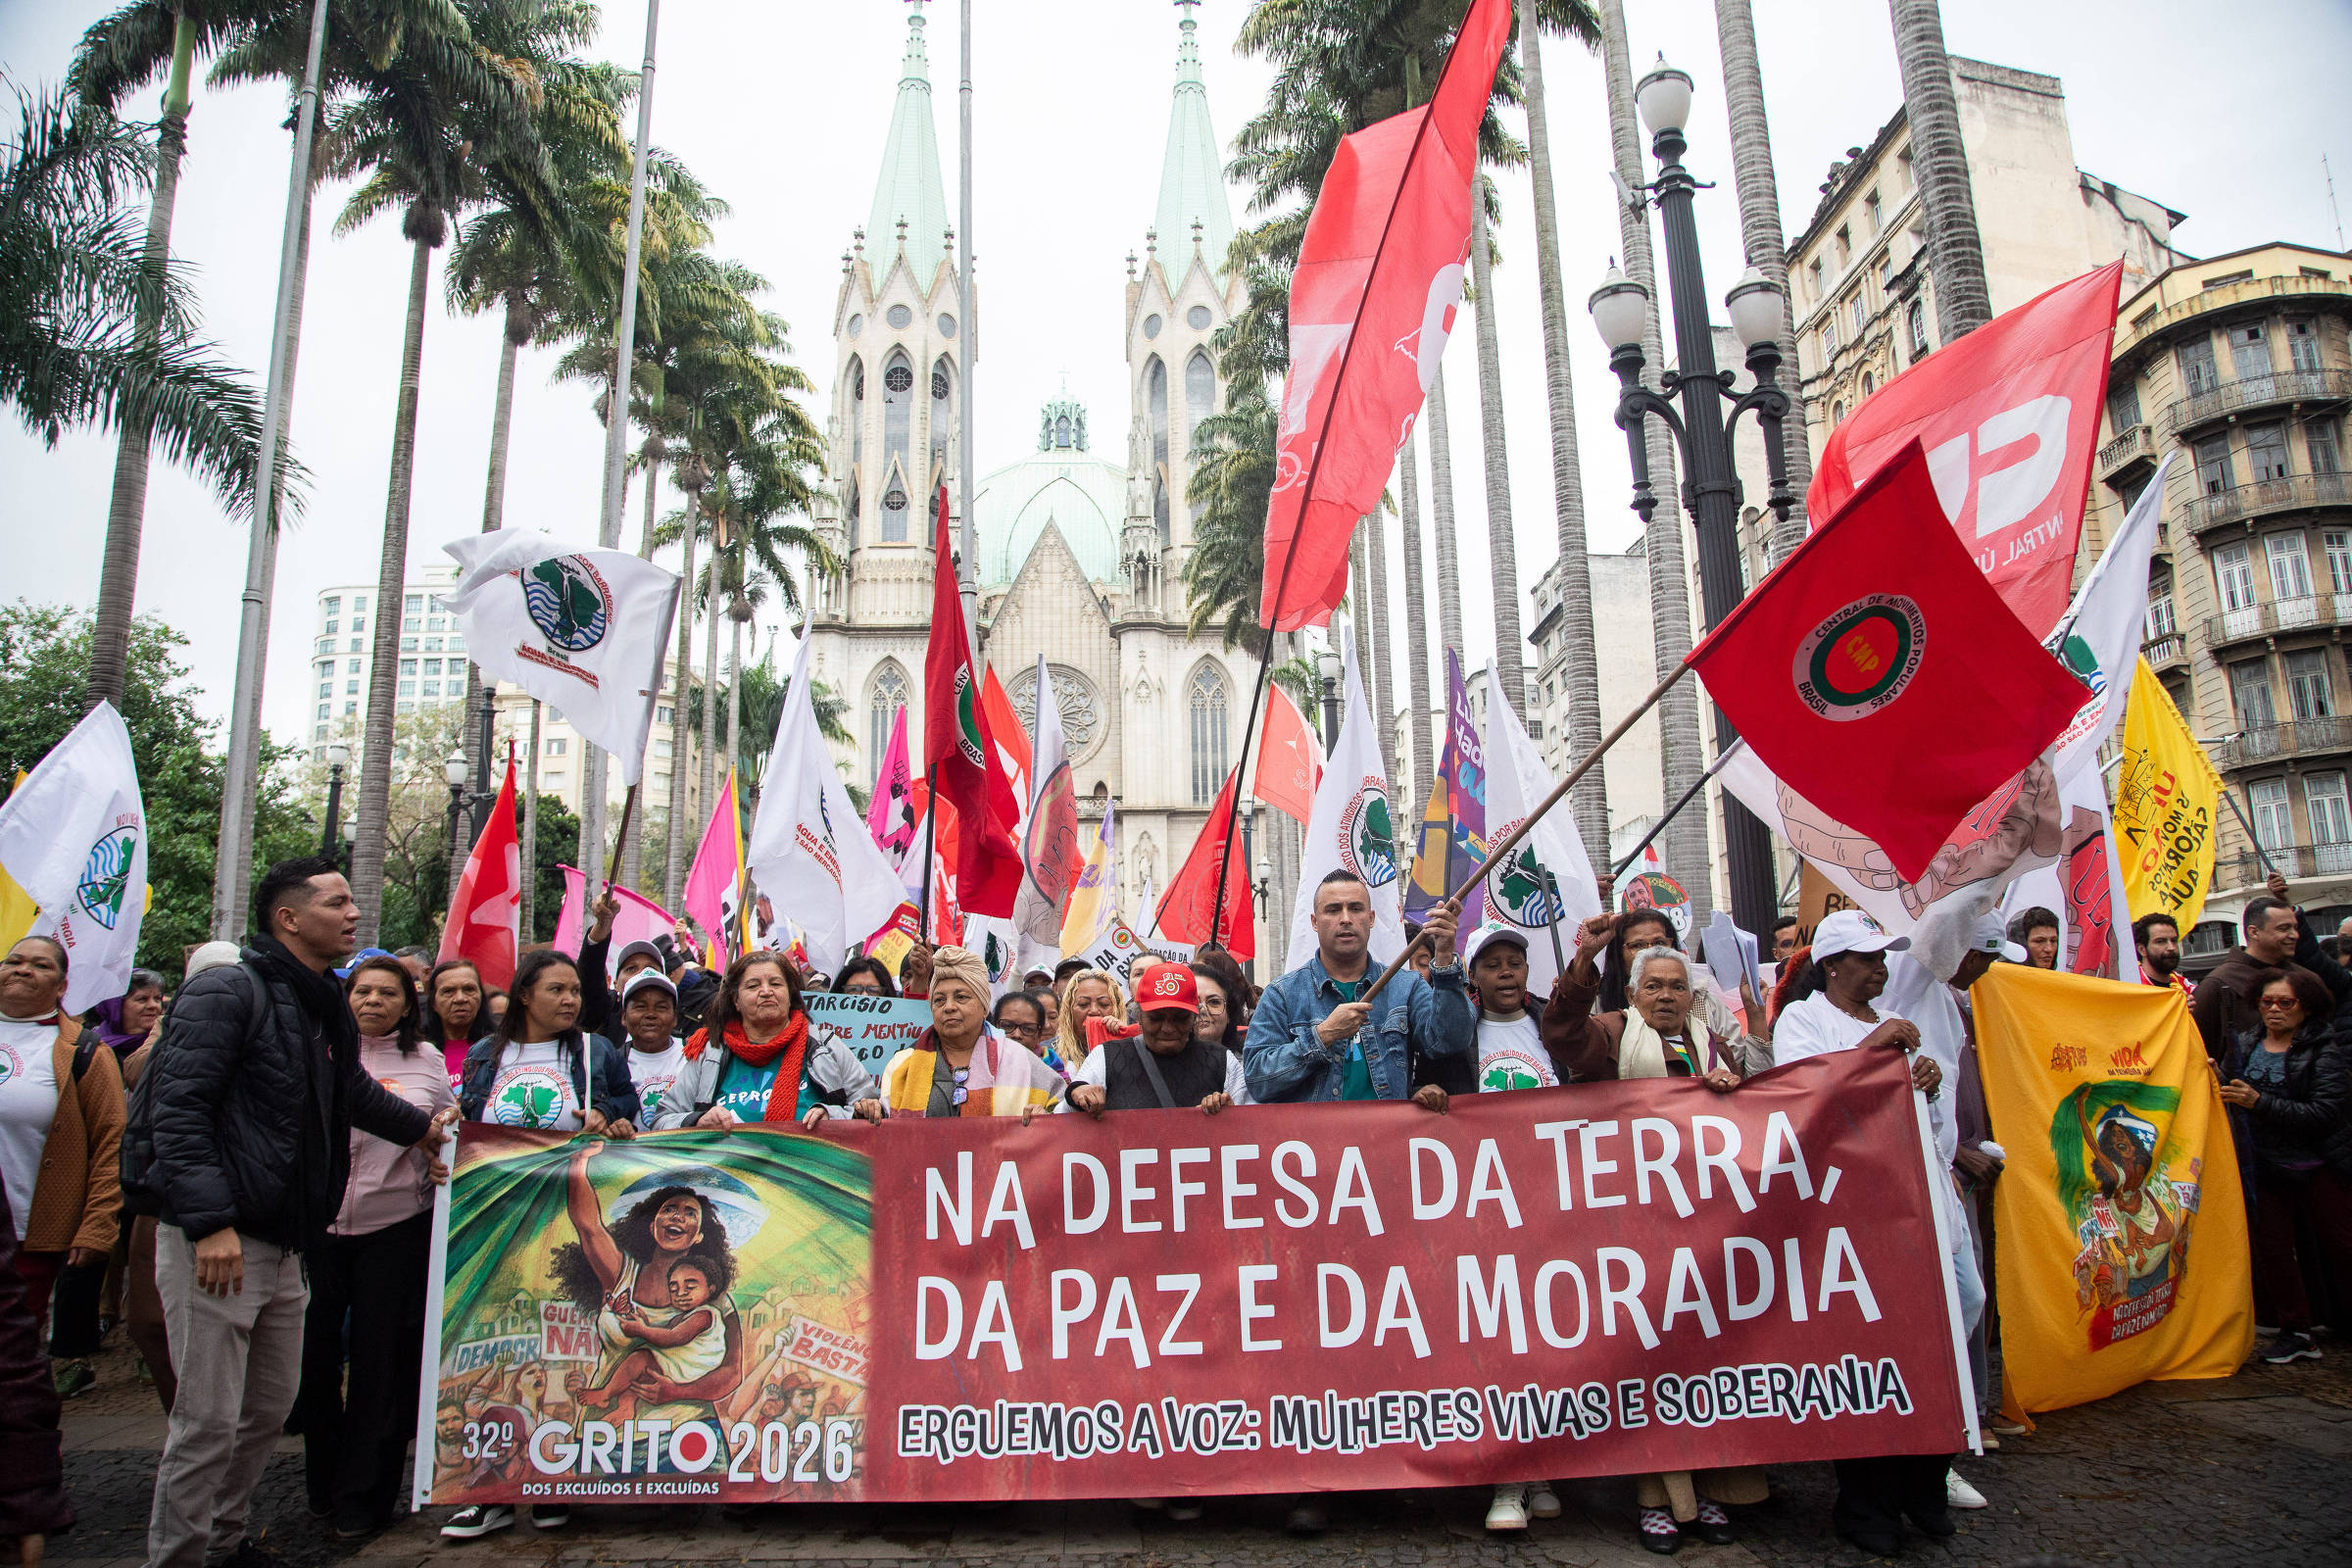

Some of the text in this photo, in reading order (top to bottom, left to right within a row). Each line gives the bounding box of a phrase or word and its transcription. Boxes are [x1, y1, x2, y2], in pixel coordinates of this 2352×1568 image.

[547, 646, 569, 661] Brasil
[1815, 595, 1925, 709] CENTRAL DE MOVIMENTOS POPULARES
[1845, 634, 1880, 674] CMP
[1797, 680, 1829, 715] BRASIL
[2077, 701, 2101, 719] Brasil
[1340, 792, 1363, 831] ATINGIDOS
[796, 822, 819, 846] ÁGUA
[817, 843, 826, 853] E
[799, 838, 814, 855] SÃO
[823, 835, 838, 857] Brasil
[1339, 833, 1350, 850] DOS
[1494, 823, 1510, 841] POR
[1095, 949, 1118, 972] DA
[1178, 951, 1188, 962] DA
[2110, 1041, 2148, 1068] VIDA
[925, 1110, 1842, 1250] NA DEFESA DA TERRA,
[915, 1226, 1883, 1373] DA PAZ E DA MORADIA
[898, 1398, 1123, 1465] ERGUEMOS
[1127, 1401, 1164, 1460] A
[1161, 1396, 1262, 1456] VOZ:
[1271, 1388, 1484, 1456] MULHERES
[1485, 1383, 1611, 1443] VIVAS
[1618, 1379, 1648, 1431] E
[1650, 1353, 1915, 1428] SOBERANIA
[462, 1420, 514, 1459] 32º
[527, 1418, 719, 1475] GRITO
[727, 1419, 855, 1485] 2026
[521, 1479, 720, 1496] DOS EXCLUÍDOS E EXCLUÍDAS
